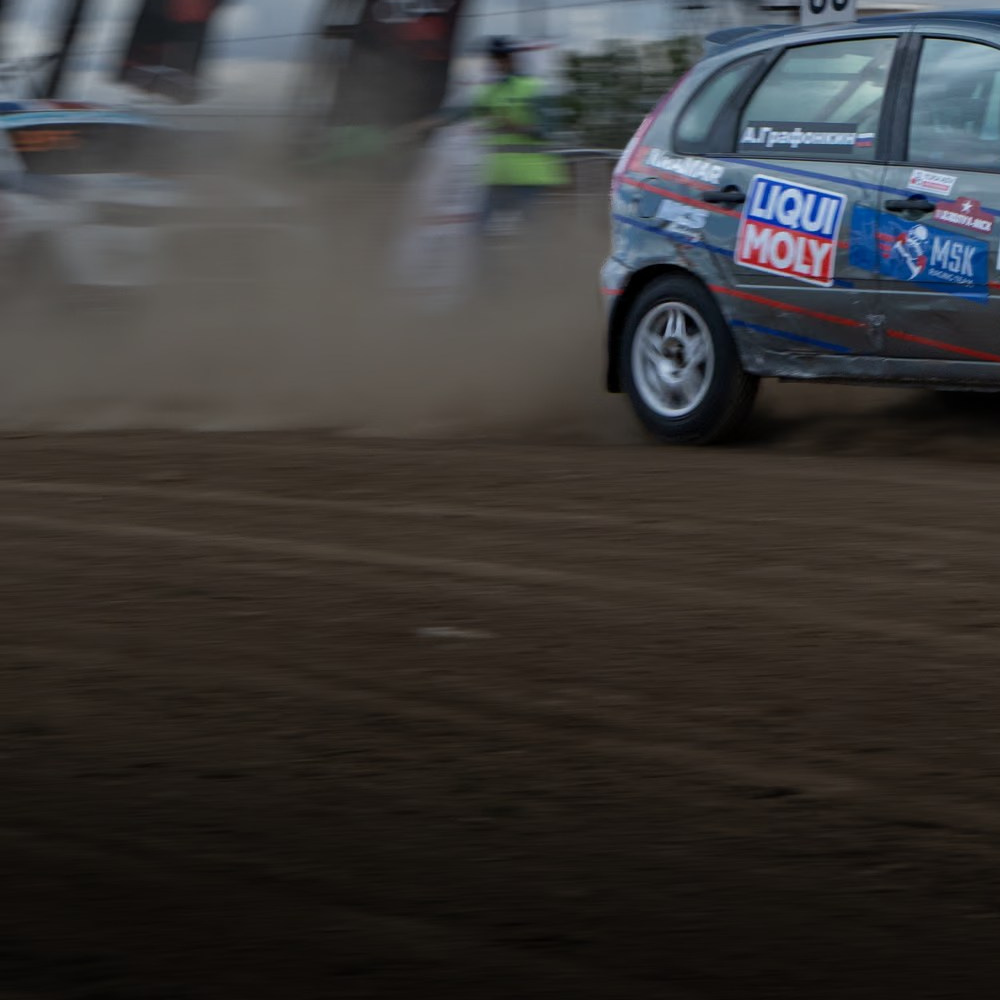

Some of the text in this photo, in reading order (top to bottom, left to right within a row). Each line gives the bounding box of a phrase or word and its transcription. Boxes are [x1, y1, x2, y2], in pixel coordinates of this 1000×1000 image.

[749, 182, 840, 234] LIQUI
[742, 223, 832, 277] MOLY
[930, 236, 976, 277] MSK
